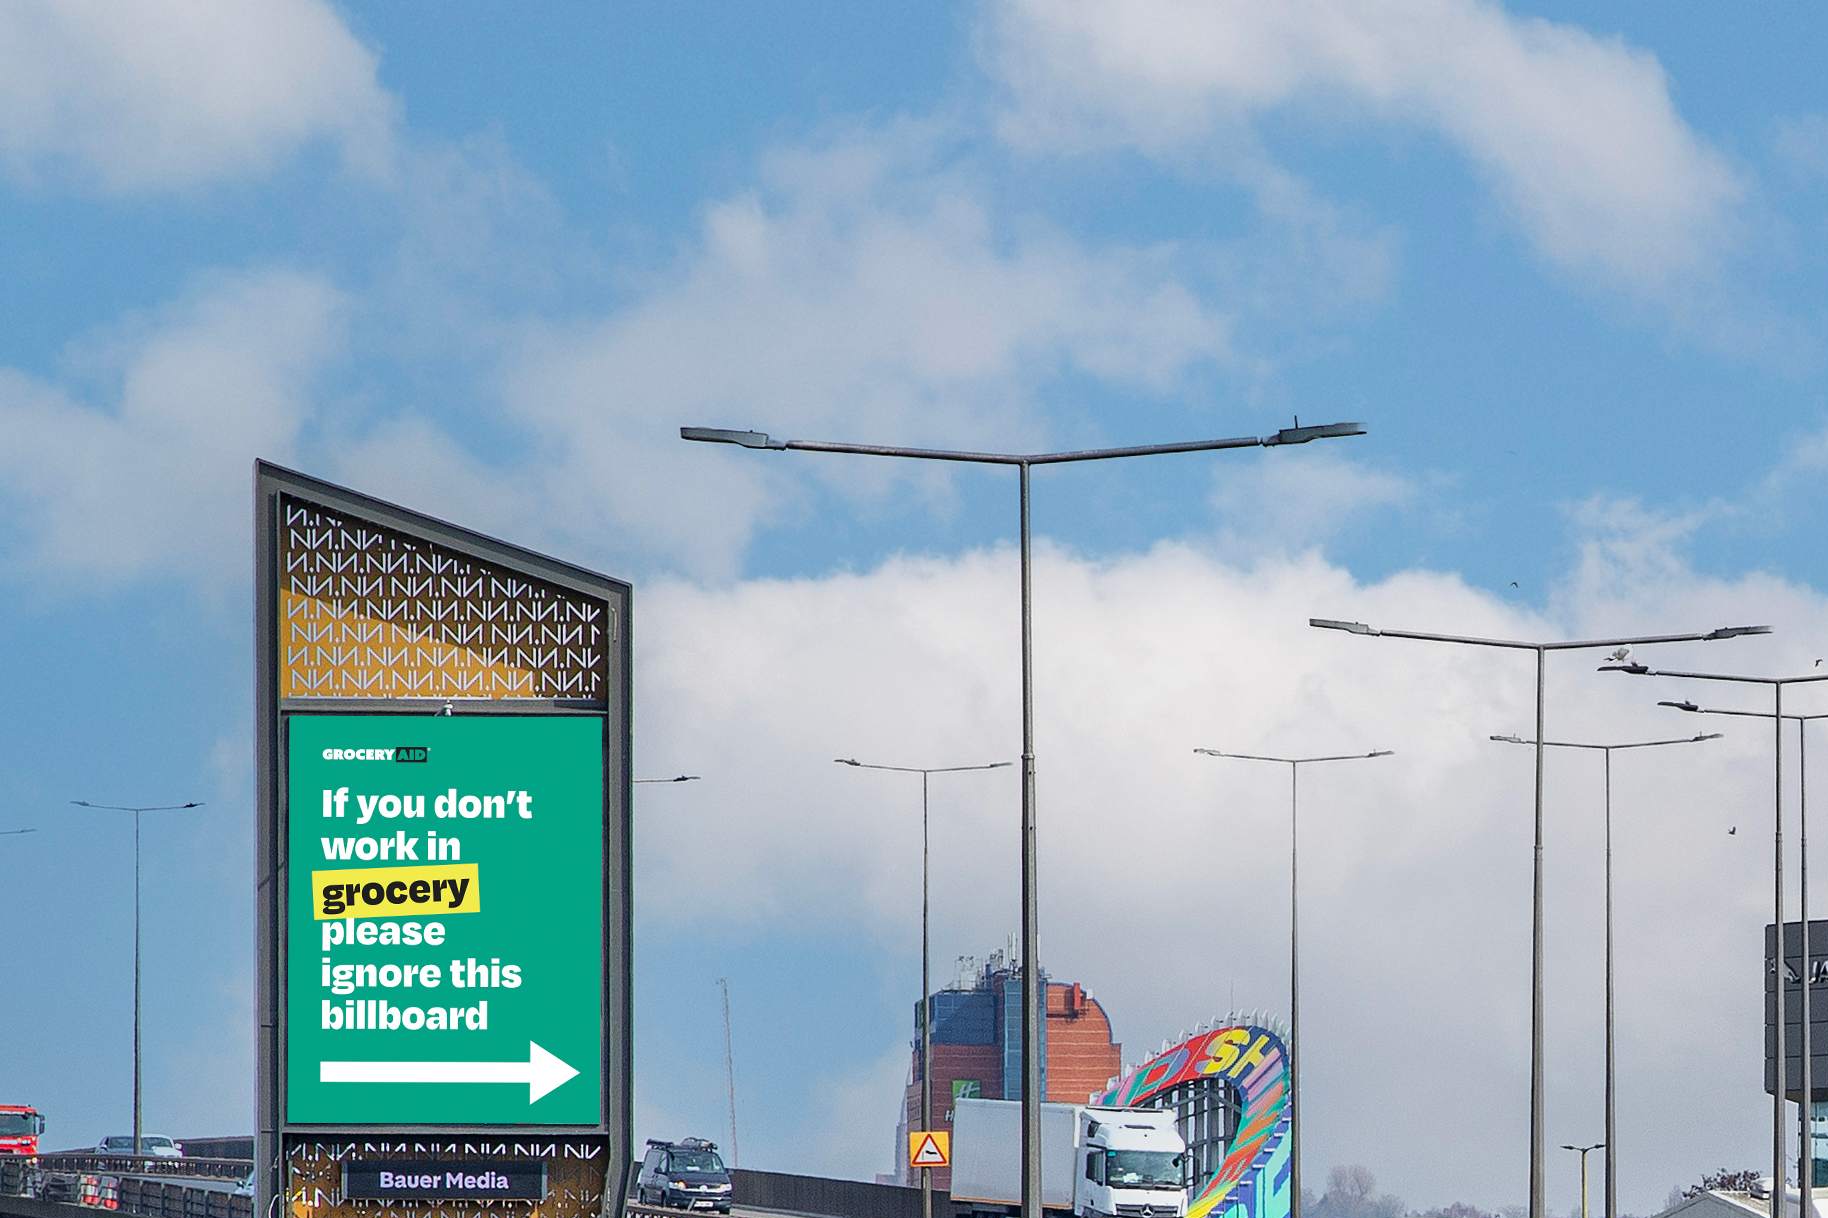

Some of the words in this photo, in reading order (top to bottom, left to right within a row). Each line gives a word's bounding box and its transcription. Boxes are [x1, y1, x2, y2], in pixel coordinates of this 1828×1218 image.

[322, 787, 348, 818] If
[356, 795, 424, 823] you
[321, 829, 419, 861] work
[427, 829, 461, 861] in
[321, 878, 470, 914] grocery
[321, 918, 446, 948] please
[321, 958, 442, 993] ignore
[450, 957, 522, 988] this
[321, 999, 488, 1031] billboard
[379, 1172, 441, 1190] Bauer
[445, 1171, 510, 1190] Media
